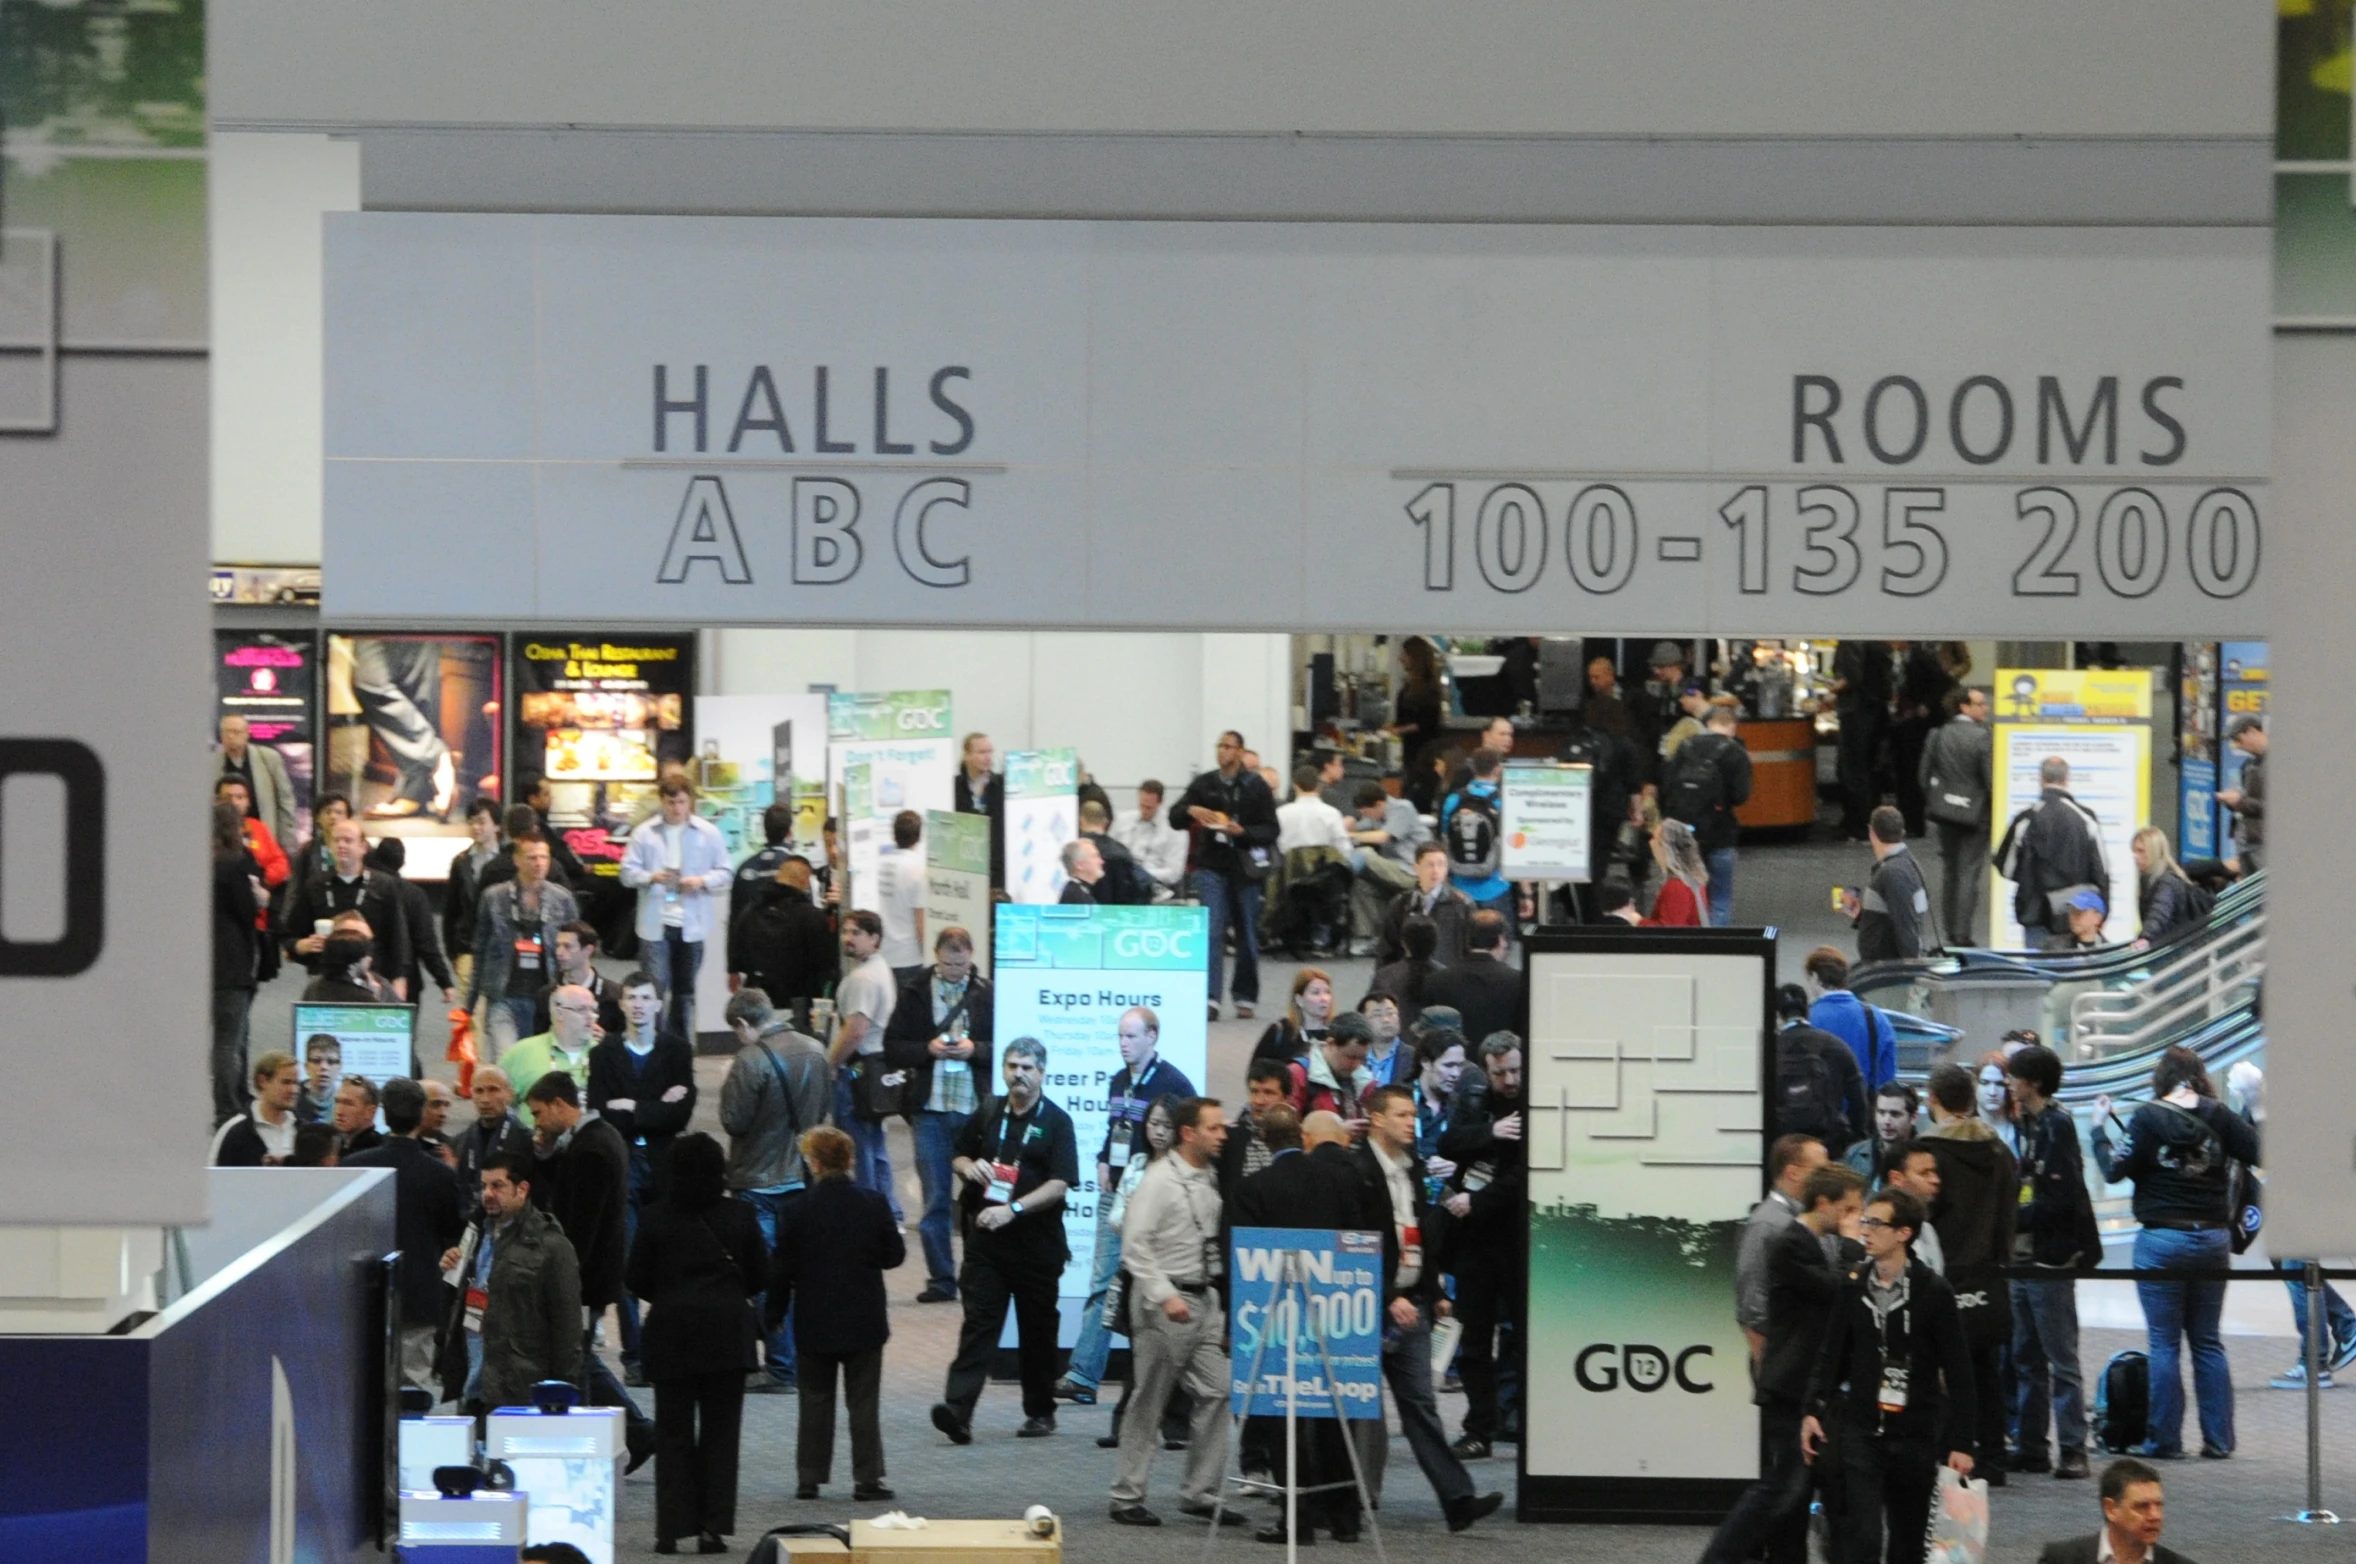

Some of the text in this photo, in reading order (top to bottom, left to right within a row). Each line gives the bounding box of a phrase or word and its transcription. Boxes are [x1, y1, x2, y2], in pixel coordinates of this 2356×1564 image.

[653, 364, 975, 456] HALLS
[1792, 374, 2187, 466] ROOMS
[1404, 482, 2261, 599] 100-135 200
[896, 707, 946, 730] GDC
[1113, 928, 1194, 959] GDC
[1038, 989, 1163, 1010] Expo Hours
[375, 1015, 409, 1029] GDC
[1235, 1247, 1334, 1284] WIN
[1355, 1267, 1374, 1286] to
[1574, 1342, 1716, 1394] GDC
[1636, 1359, 1657, 1377] 12
